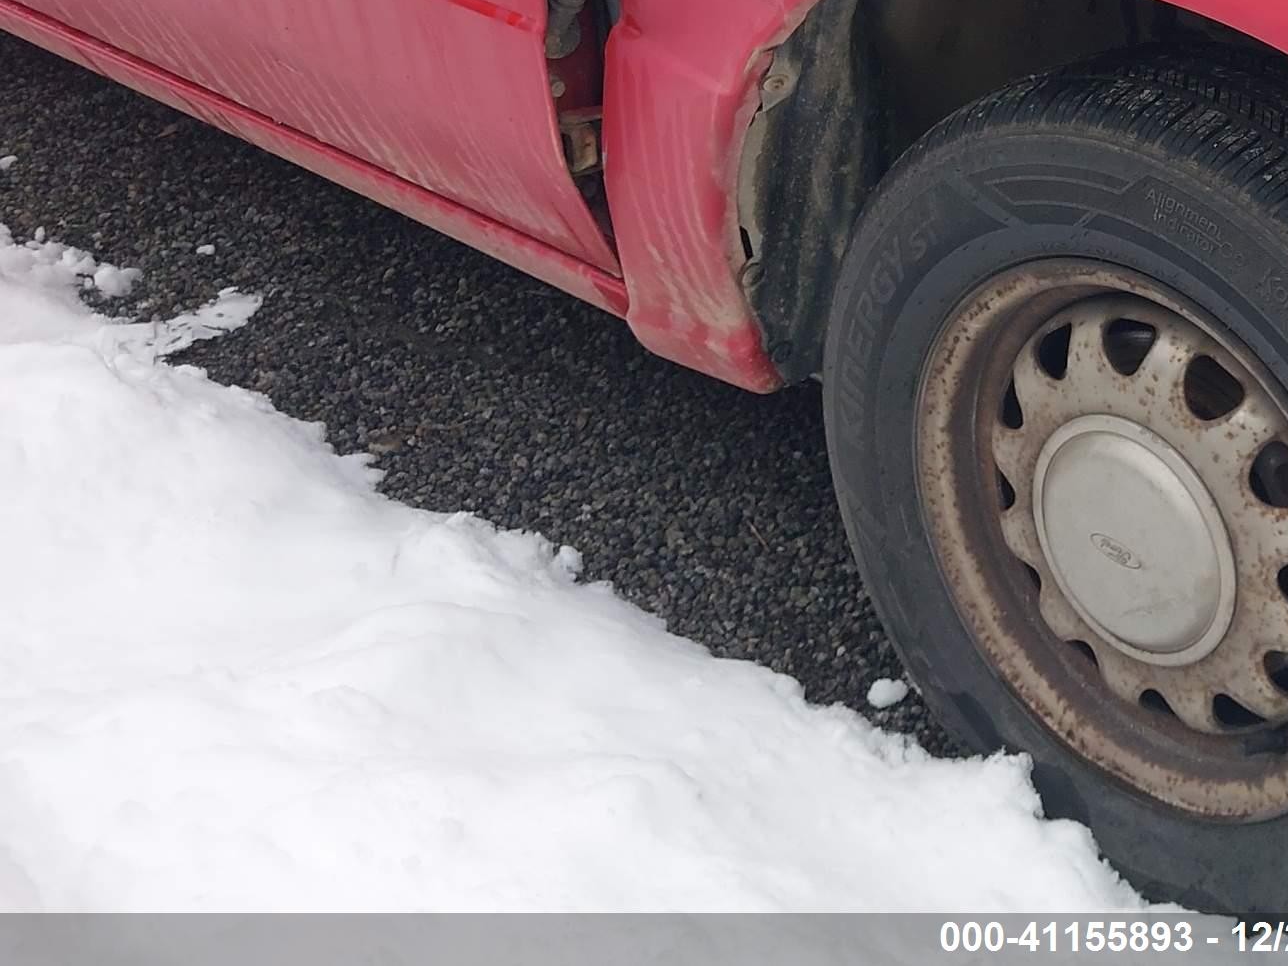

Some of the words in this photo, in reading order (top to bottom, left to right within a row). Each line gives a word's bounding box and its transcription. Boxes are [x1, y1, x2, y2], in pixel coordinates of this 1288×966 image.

[1143, 186, 1222, 241] Alignment
[1152, 203, 1216, 252] Indicator
[1095, 536, 1135, 566] Ford
